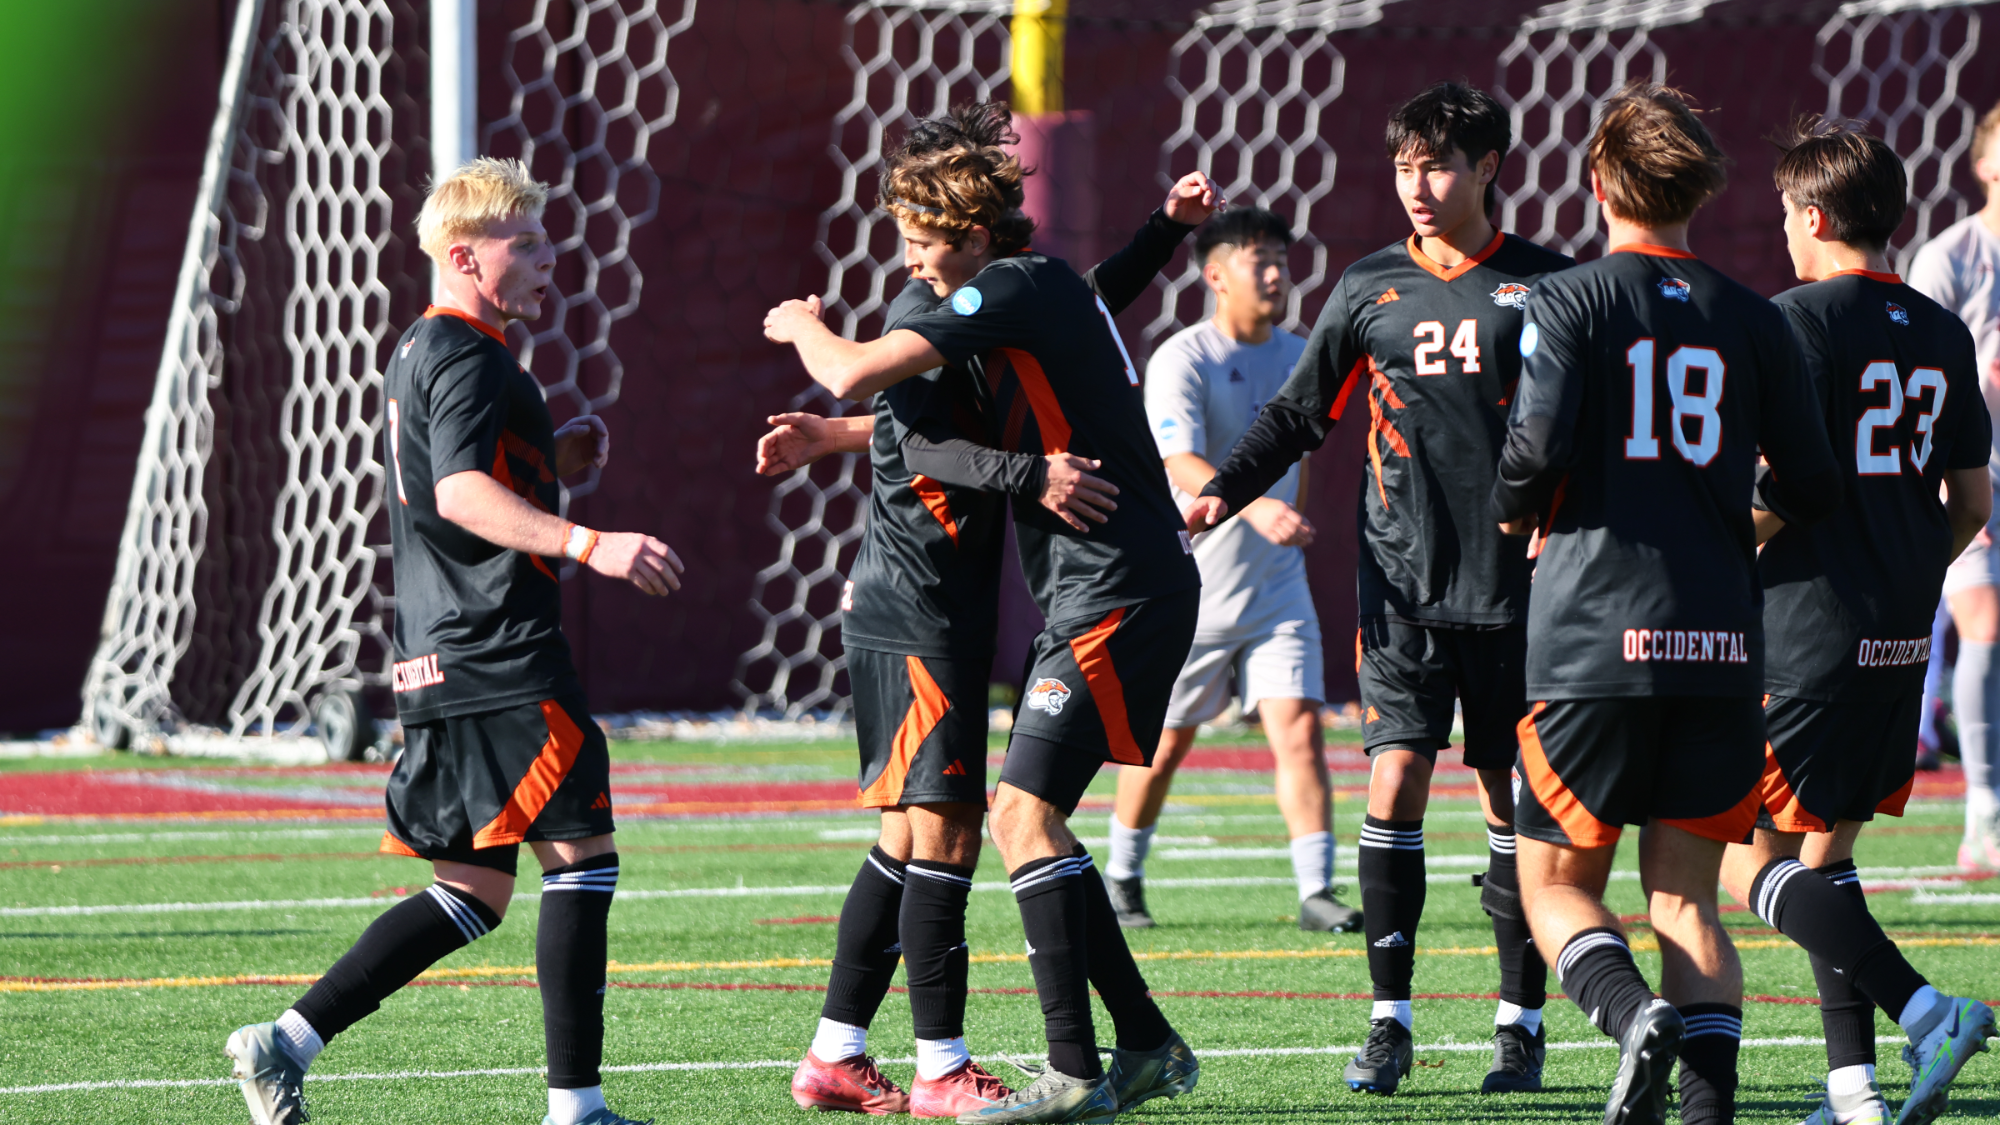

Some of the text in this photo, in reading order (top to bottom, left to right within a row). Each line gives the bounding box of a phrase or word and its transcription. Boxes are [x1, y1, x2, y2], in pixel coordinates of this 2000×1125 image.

[1412, 318, 1482, 376] 24
[1624, 337, 1728, 467] 18
[1855, 359, 1949, 477] 23
[1623, 628, 1748, 662] OCCIDENTAL
